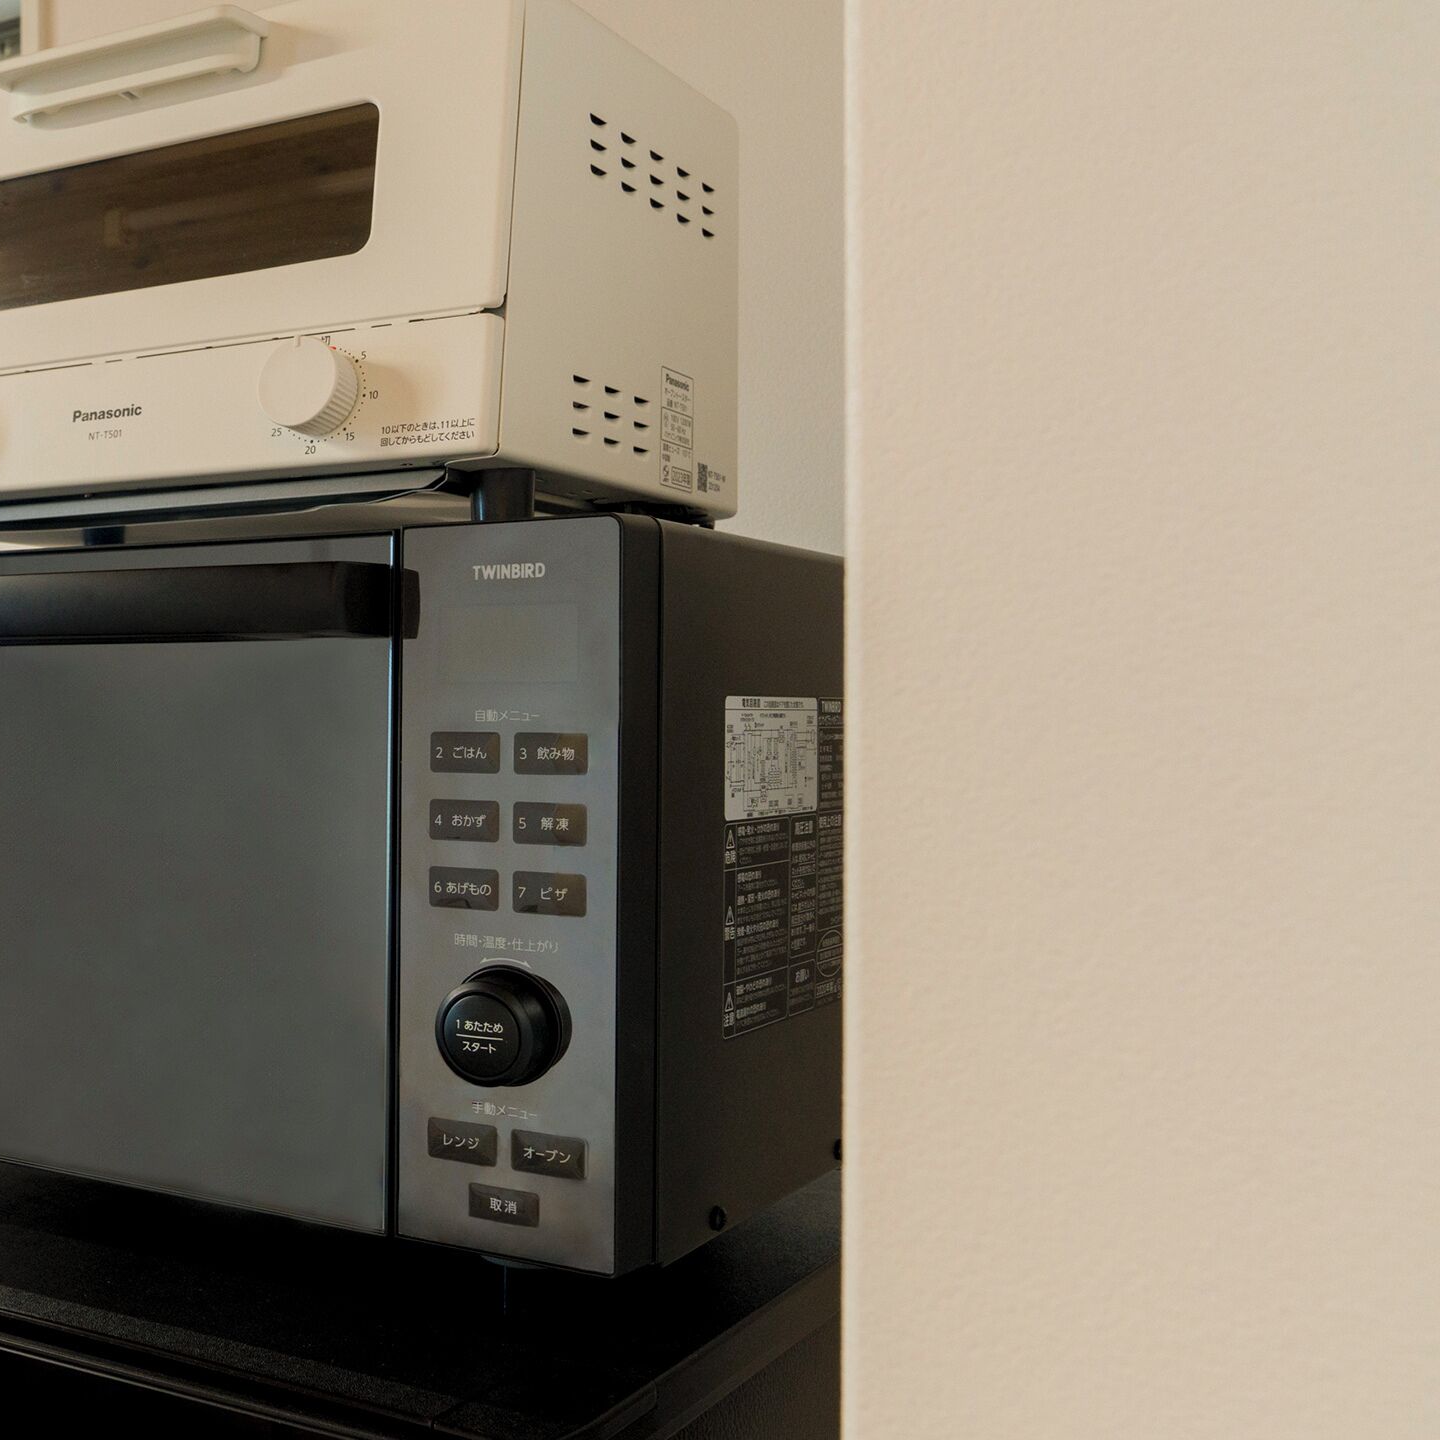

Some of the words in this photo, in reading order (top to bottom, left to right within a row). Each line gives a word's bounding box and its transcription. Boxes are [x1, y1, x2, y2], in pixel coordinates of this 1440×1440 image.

[361, 351, 367, 360] 5
[369, 390, 379, 399] 10
[72, 403, 142, 423] Panasonic
[271, 428, 282, 437] 25
[381, 417, 475, 434] 10以下のときは、11以上に
[88, 429, 122, 441] NT-T501
[345, 432, 355, 441] 15
[380, 431, 475, 447] 回してからもどしてください
[305, 445, 316, 455] 20
[472, 562, 546, 580] TWINBIRD
[474, 709, 540, 722] 自動メニュー
[436, 747, 443, 759] 2
[452, 746, 487, 759] ごはん
[519, 747, 527, 760] 3
[537, 747, 575, 761] 飲み物
[434, 814, 442, 826] 4
[451, 814, 486, 827] おかず
[519, 817, 527, 830] 5
[540, 817, 569, 831] 解凍
[434, 881, 441, 893] 6
[446, 882, 492, 895] あげもの
[518, 886, 527, 899] 7
[540, 887, 568, 901] ピザ
[454, 933, 559, 953] 時間・温度・仕上がり
[456, 1019, 461, 1029] 1
[463, 1020, 504, 1034] あたため
[462, 1040, 497, 1054] スタート
[471, 1100, 538, 1120] 手動メニュー
[443, 1133, 480, 1150] レンジ
[523, 1146, 571, 1164] オーブン
[490, 1197, 517, 1215] 取消
